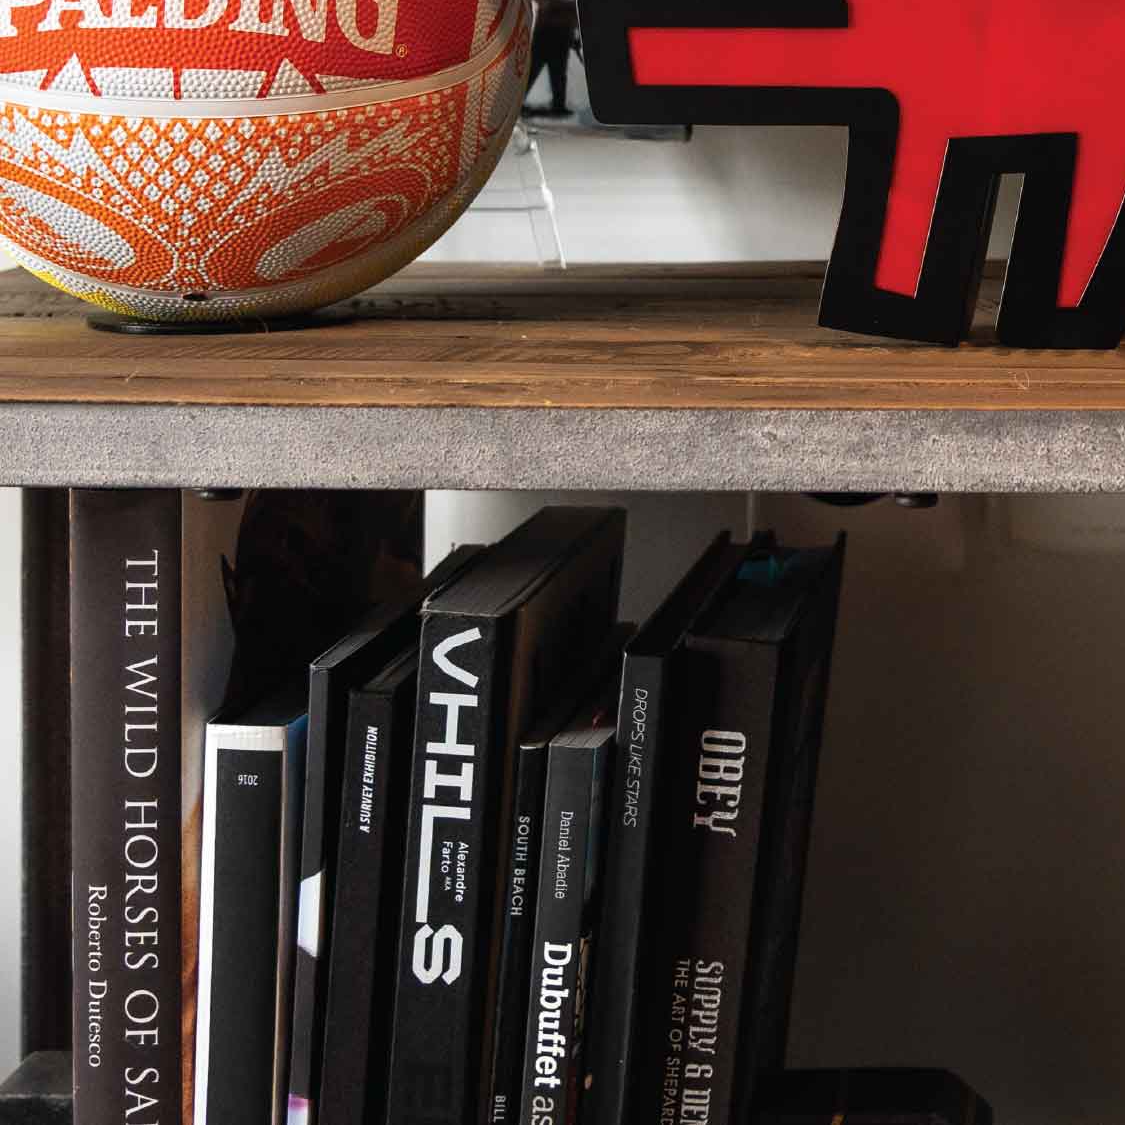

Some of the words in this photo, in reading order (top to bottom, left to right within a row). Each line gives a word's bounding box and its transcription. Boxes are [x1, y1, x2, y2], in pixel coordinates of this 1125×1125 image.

[124, 548, 159, 638] THE
[124, 657, 159, 779] WILD
[631, 687, 648, 743] DROPS
[238, 775, 259, 786] 2016
[362, 725, 379, 783] EXHIBITION
[627, 743, 643, 777] LIKE
[359, 785, 374, 824] SURVEY
[412, 627, 482, 985] VHILS
[624, 777, 641, 828] STARS
[693, 729, 746, 837] OBEY
[360, 825, 370, 834] A
[515, 815, 531, 862] SOUTH
[558, 811, 574, 851] Daniel
[440, 841, 453, 873] Farto
[455, 841, 470, 902] Alexandre
[555, 854, 571, 899] Abadie
[124, 798, 159, 970] HORSES
[510, 868, 527, 916] BEACH
[88, 884, 108, 972] Roberto
[674, 959, 691, 988] THE
[88, 980, 108, 1068] Dutesco
[124, 989, 159, 1046] OF
[534, 941, 573, 1088] Dubuffet
[671, 993, 687, 1024] ART
[687, 959, 725, 1055] SUPPLY
[669, 1028, 683, 1051] OF
[124, 1067, 159, 1125] SA
[493, 1095, 507, 1123] BILL
